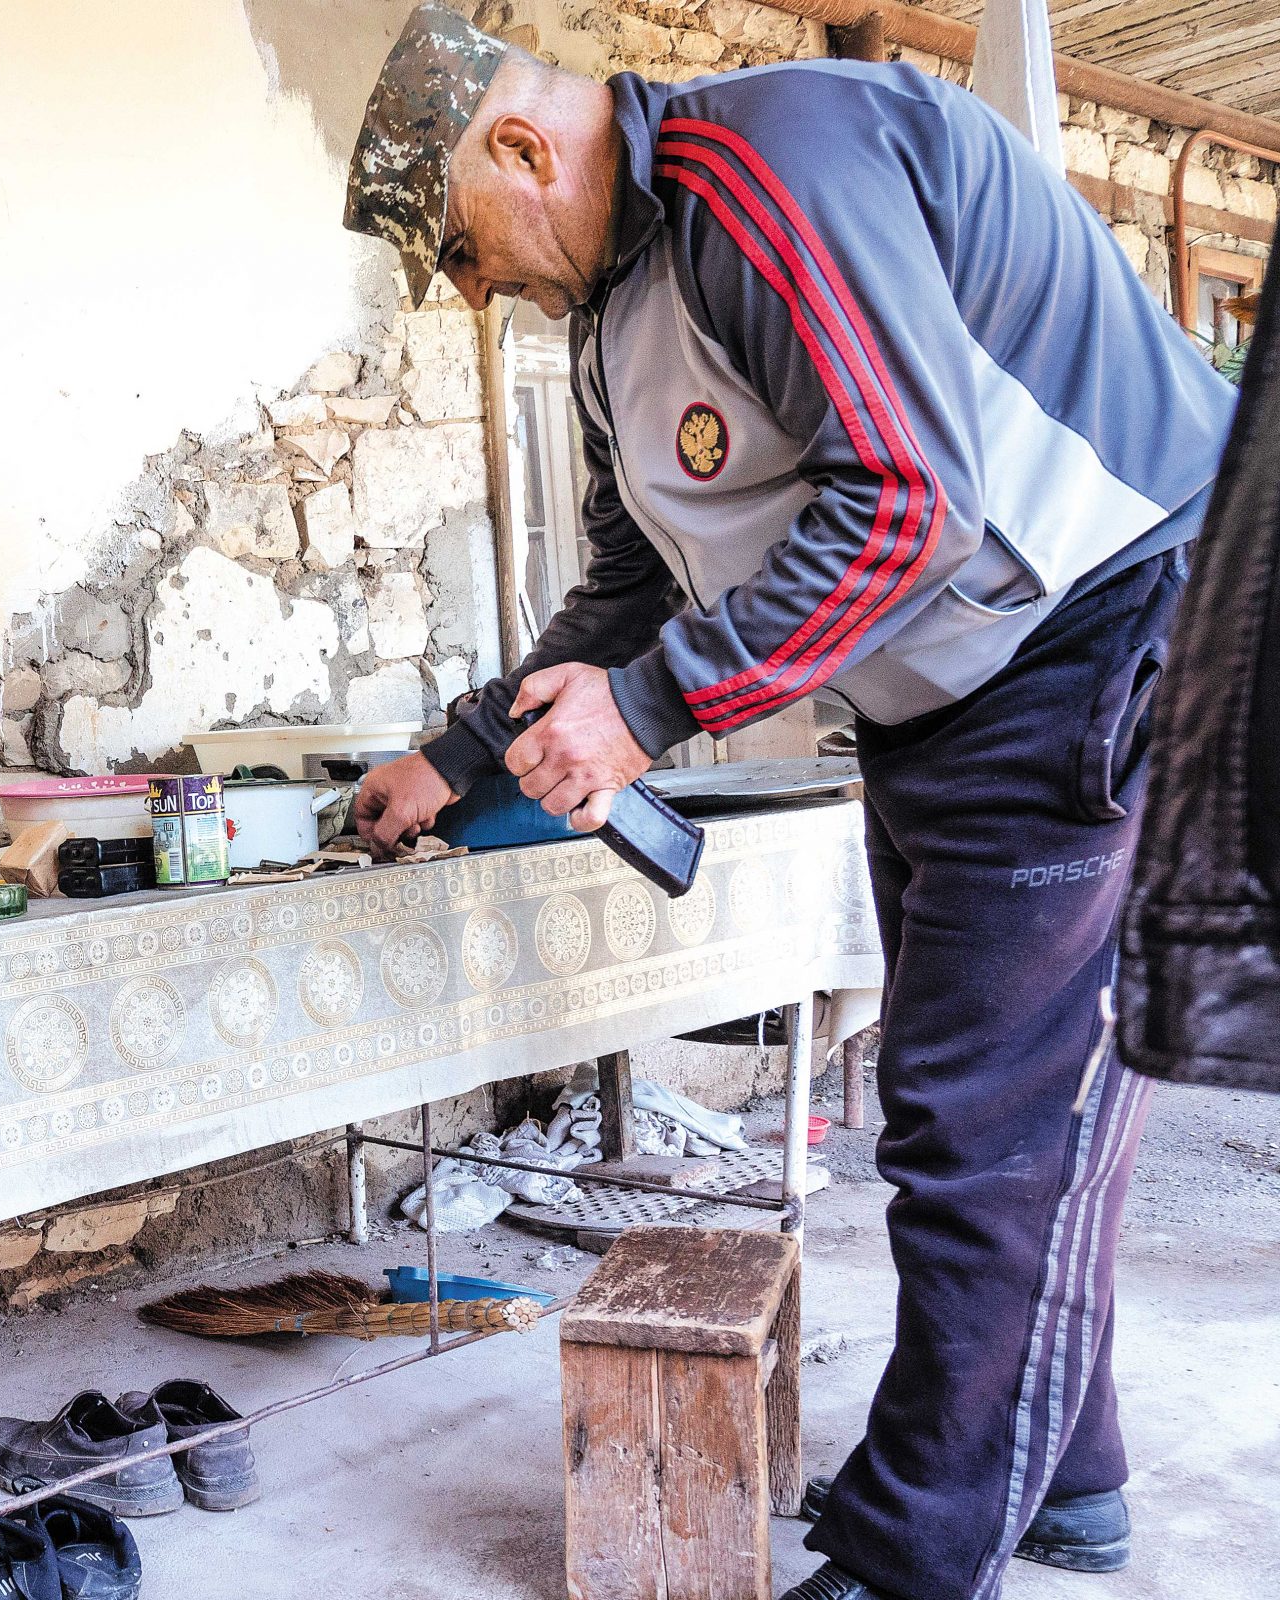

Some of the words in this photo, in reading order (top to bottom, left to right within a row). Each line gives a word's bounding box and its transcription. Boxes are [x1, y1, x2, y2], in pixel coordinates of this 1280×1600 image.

[153, 795, 177, 813] SUN
[188, 792, 214, 810] TOP
[1011, 848, 1126, 889] PORSCHE
